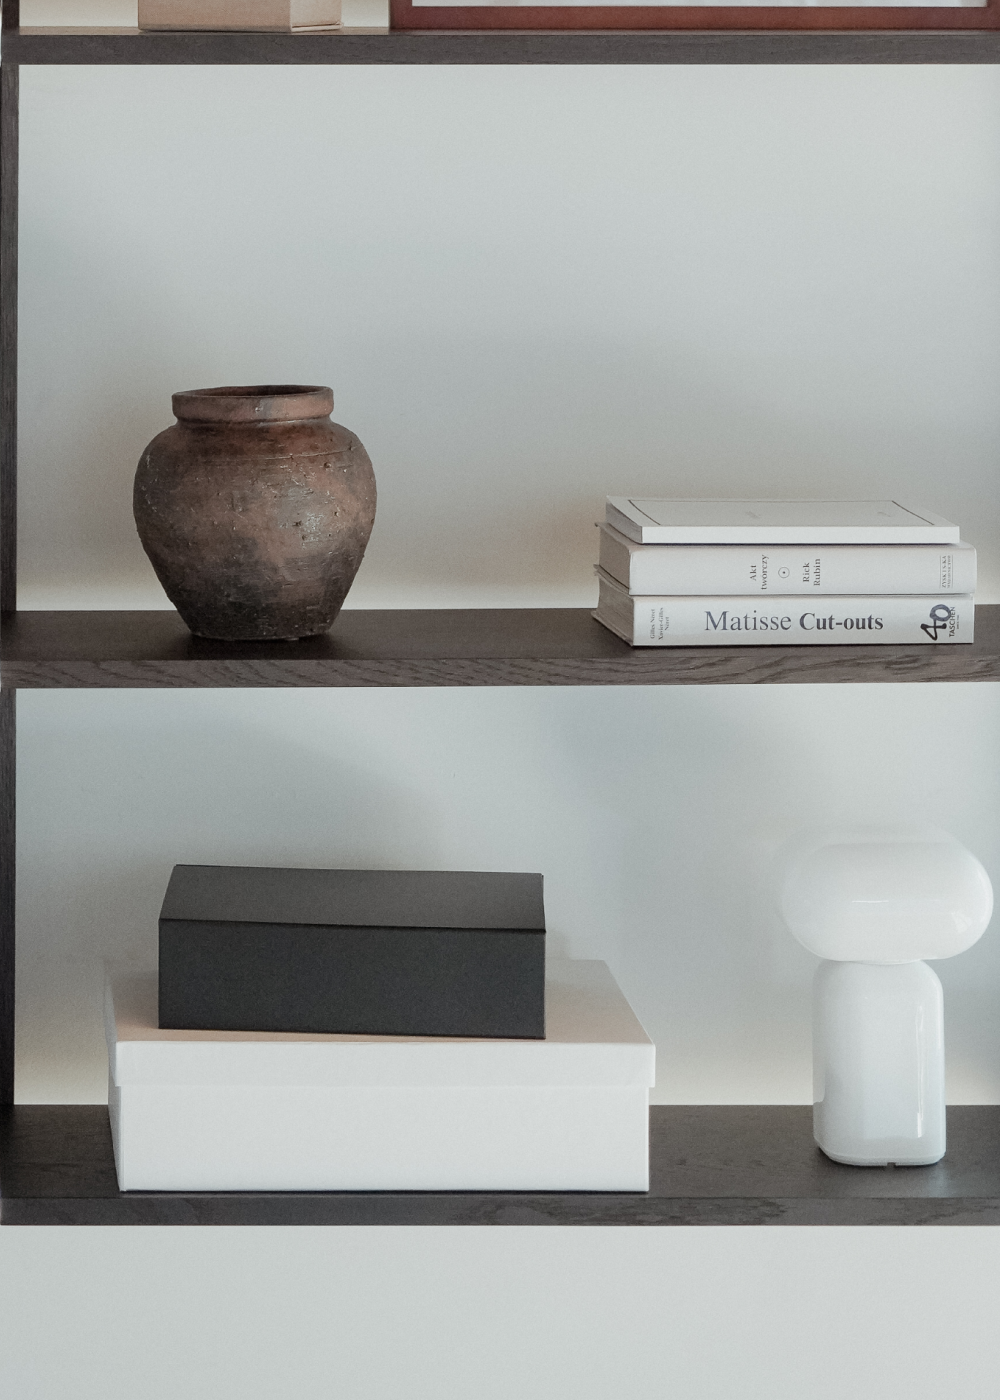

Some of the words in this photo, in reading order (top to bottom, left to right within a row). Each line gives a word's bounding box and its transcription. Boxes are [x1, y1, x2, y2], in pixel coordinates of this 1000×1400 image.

[749, 565, 757, 582] Akt
[802, 562, 810, 582] Rick
[813, 558, 821, 586] Rubin
[704, 610, 791, 631] Matisse
[799, 612, 884, 630] Cut-outs
[920, 604, 951, 641] 40
